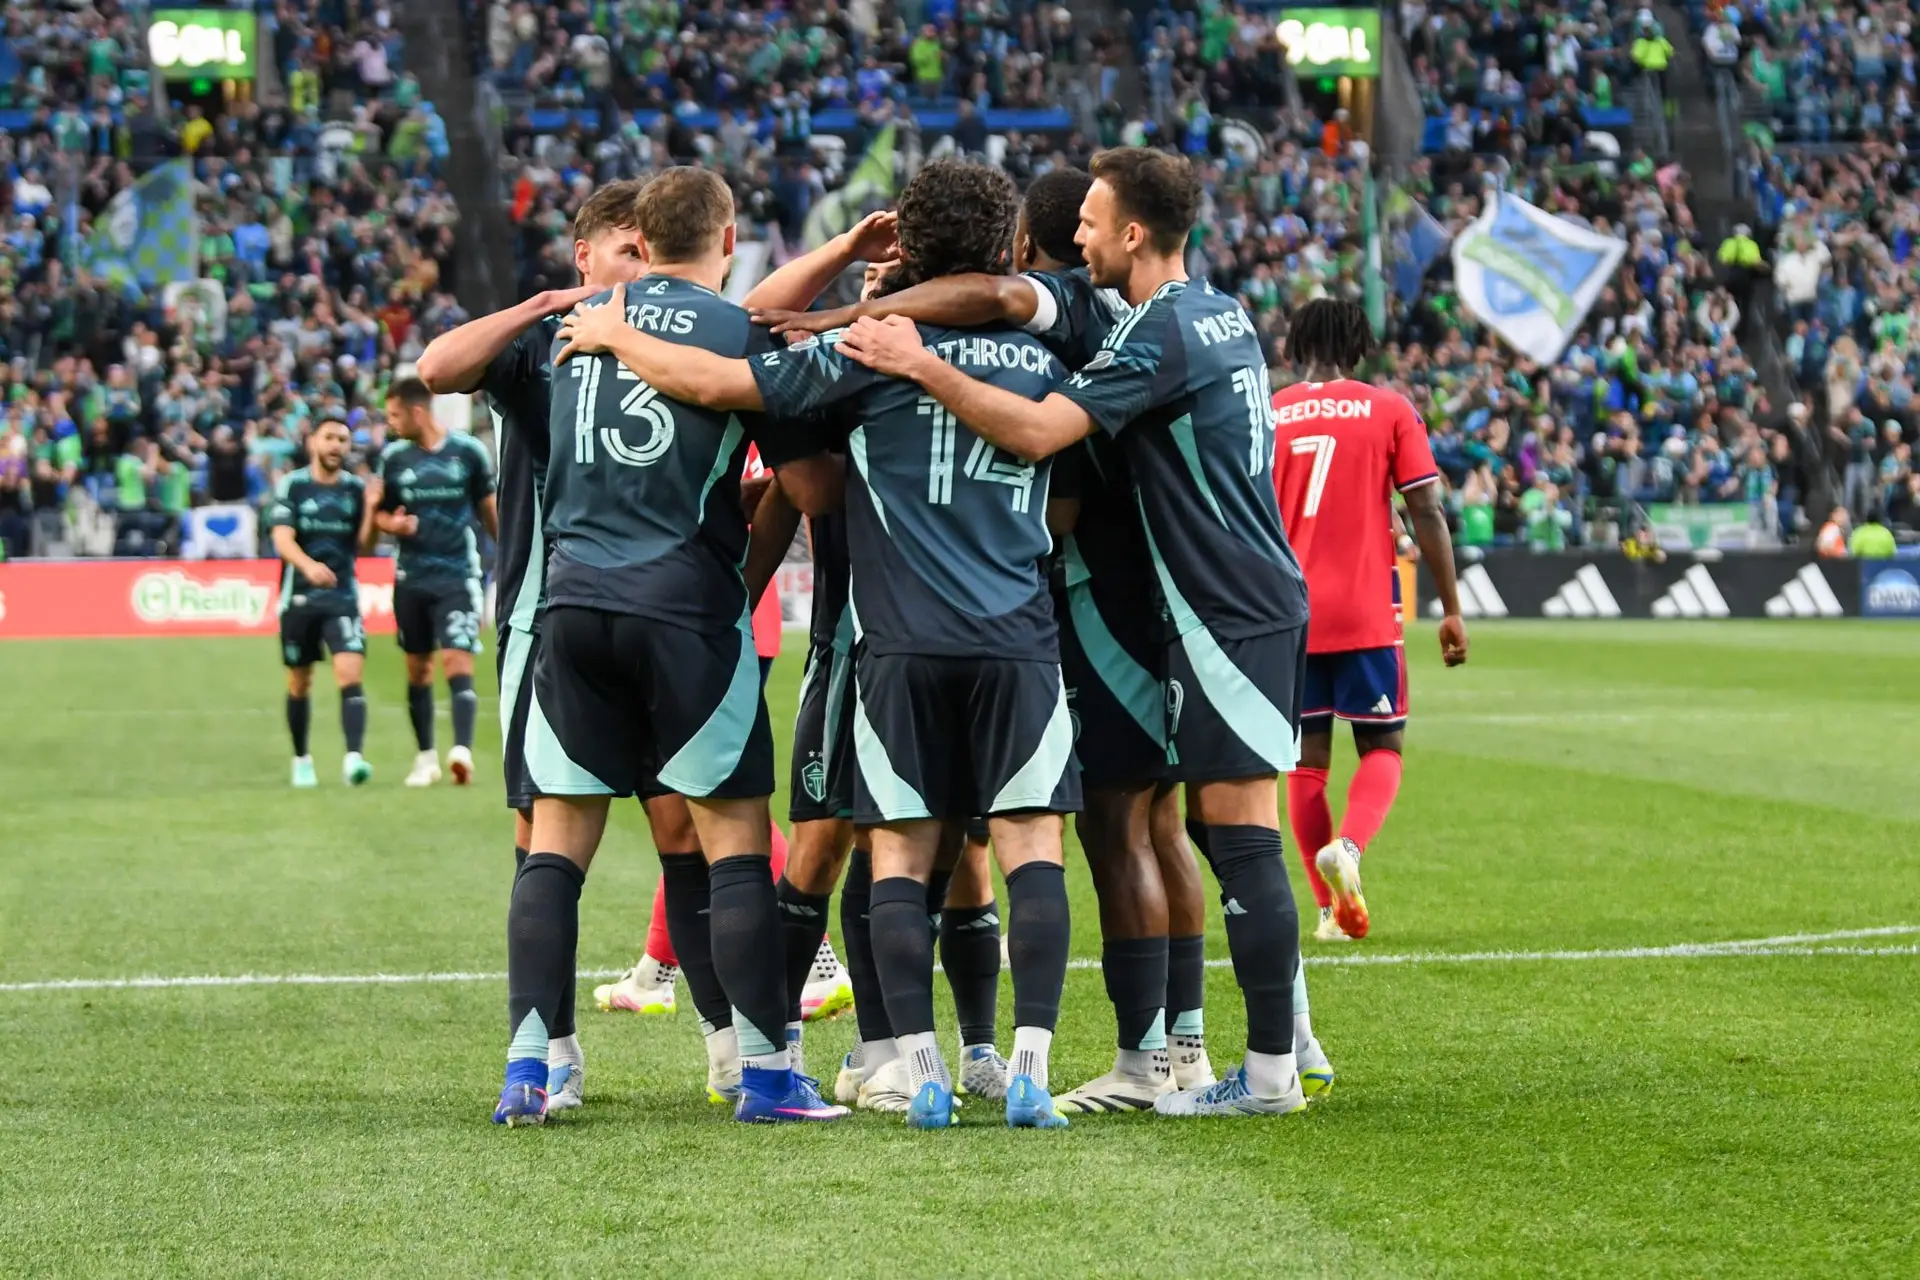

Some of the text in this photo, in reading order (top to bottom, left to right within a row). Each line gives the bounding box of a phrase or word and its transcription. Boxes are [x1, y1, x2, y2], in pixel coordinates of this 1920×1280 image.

[924, 338, 1053, 379] THROCK
[571, 356, 675, 467] 13
[916, 396, 1035, 514] 14
[1290, 435, 1337, 518] 7
[446, 610, 481, 638] 25
